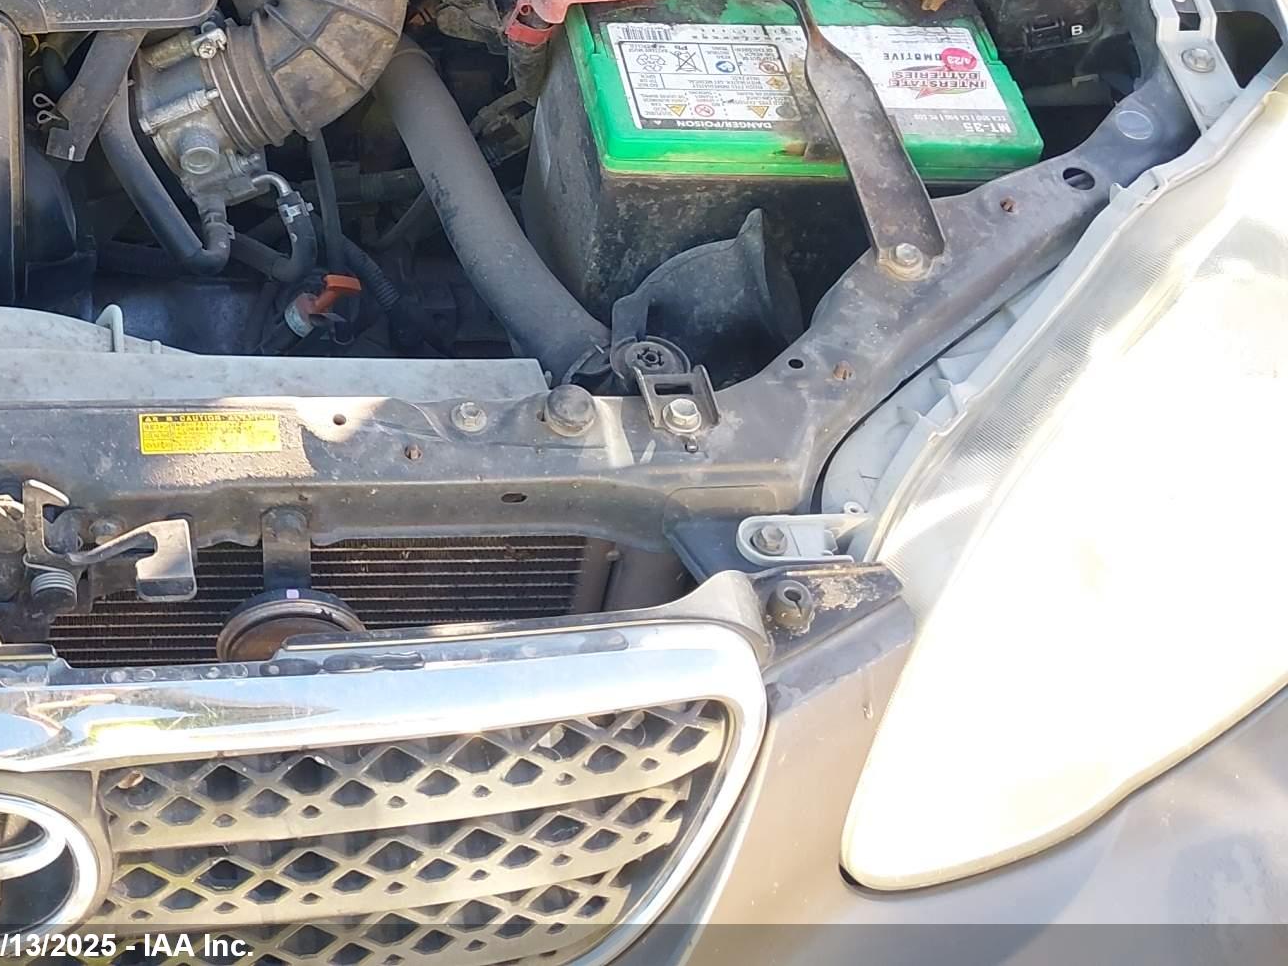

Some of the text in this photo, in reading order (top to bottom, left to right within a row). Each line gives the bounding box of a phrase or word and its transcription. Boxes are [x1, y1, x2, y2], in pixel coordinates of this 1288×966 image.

[1070, 24, 1083, 36] B
[883, 52, 942, 61] OMOTIVE
[893, 71, 979, 80] BATTERIES
[890, 79, 985, 89] INTERSTATE
[677, 119, 773, 129] DANGER/POISON
[963, 122, 1011, 133] MT-35
[179, 414, 222, 422] CAUTION
